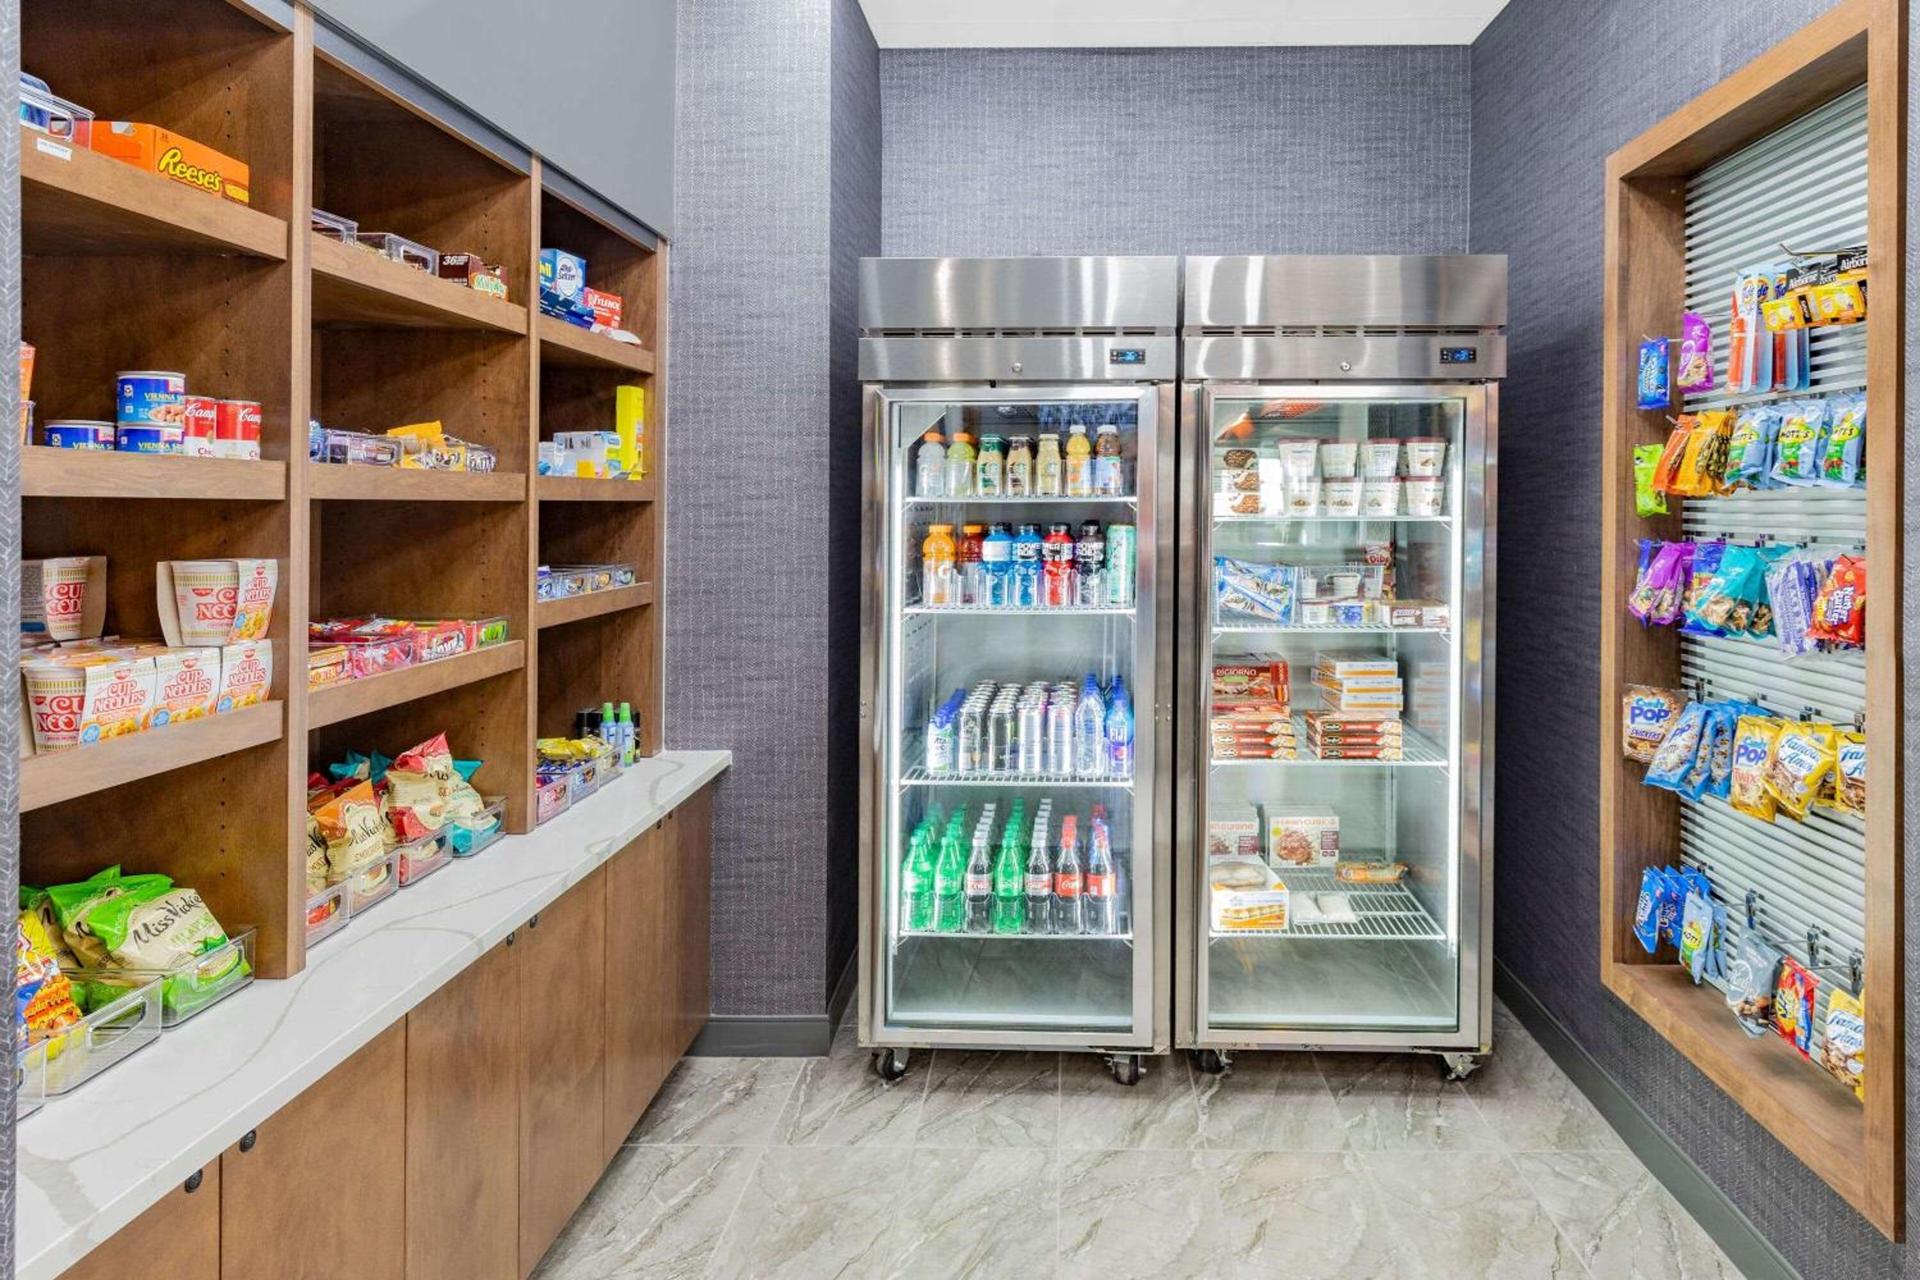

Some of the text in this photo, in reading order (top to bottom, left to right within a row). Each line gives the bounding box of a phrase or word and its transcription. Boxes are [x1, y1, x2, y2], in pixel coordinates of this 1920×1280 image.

[158, 147, 222, 192] Reese's
[443, 256, 457, 266] 36
[143, 391, 176, 401] VIENNA
[176, 669, 204, 684] CUP
[107, 680, 138, 697] CUP
[164, 678, 212, 700] NOODLES
[92, 690, 147, 715] NOODLES
[132, 914, 176, 950] Miss
